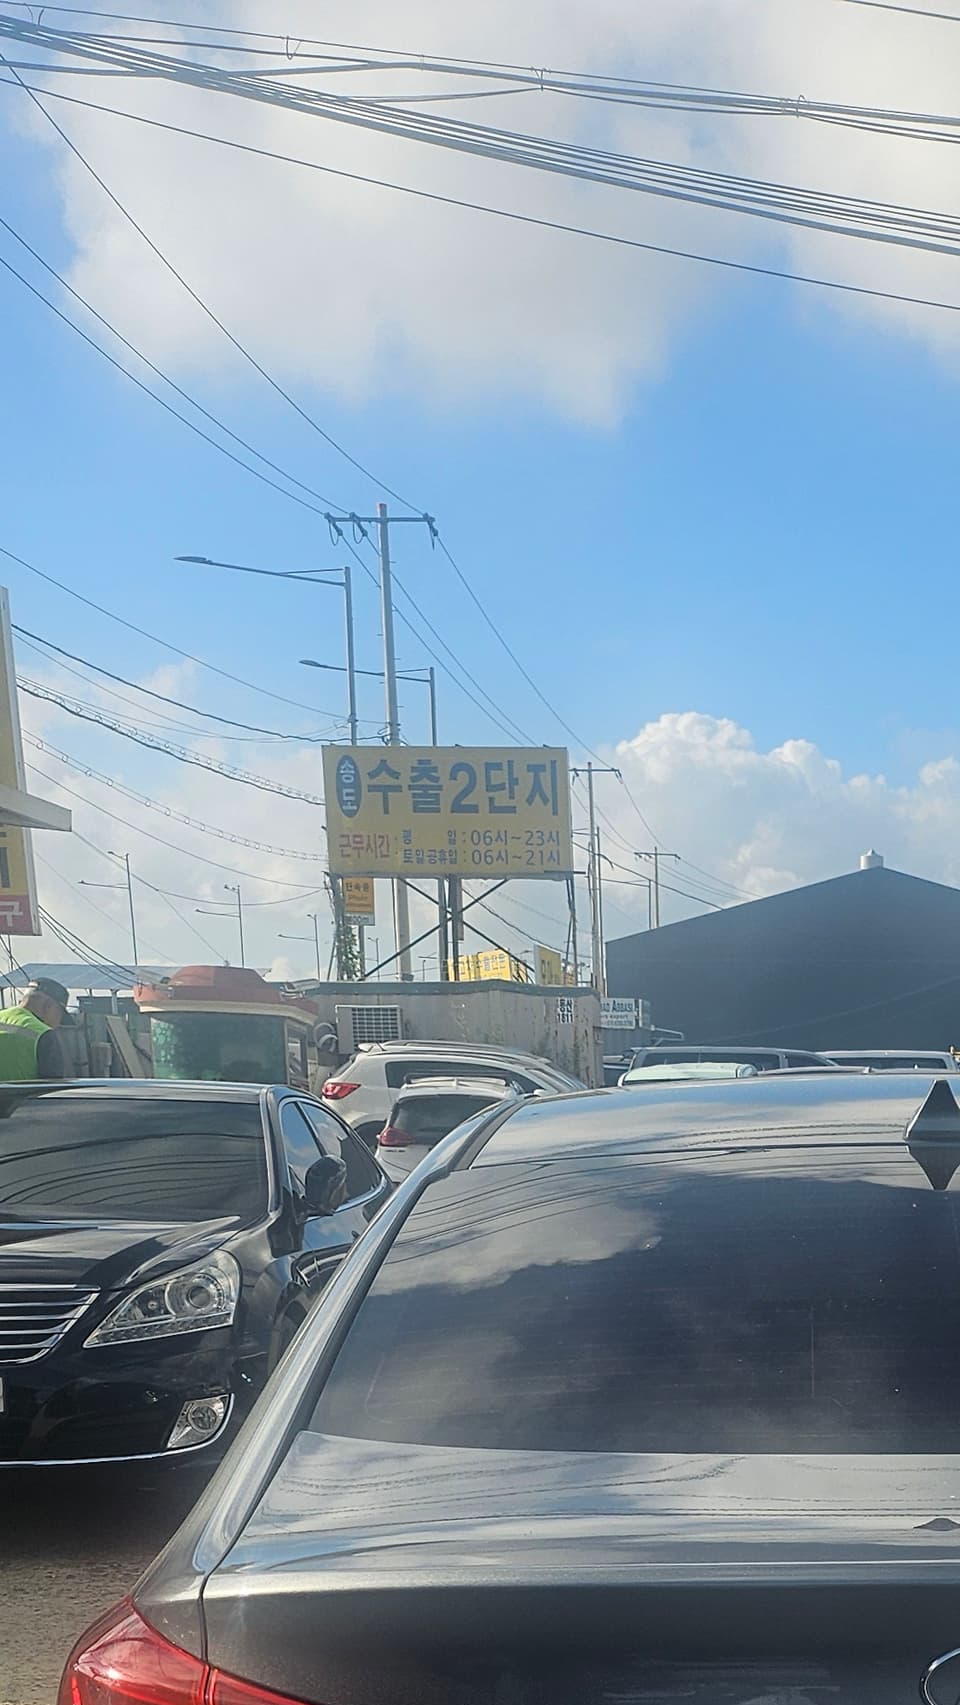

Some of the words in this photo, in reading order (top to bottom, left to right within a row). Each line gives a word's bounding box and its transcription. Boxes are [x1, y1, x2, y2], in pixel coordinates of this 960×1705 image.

[340, 761, 357, 811] 송도
[367, 759, 559, 816] 수출2단지
[339, 832, 390, 859] 근무시간
[403, 848, 458, 865] 토일공휴일
